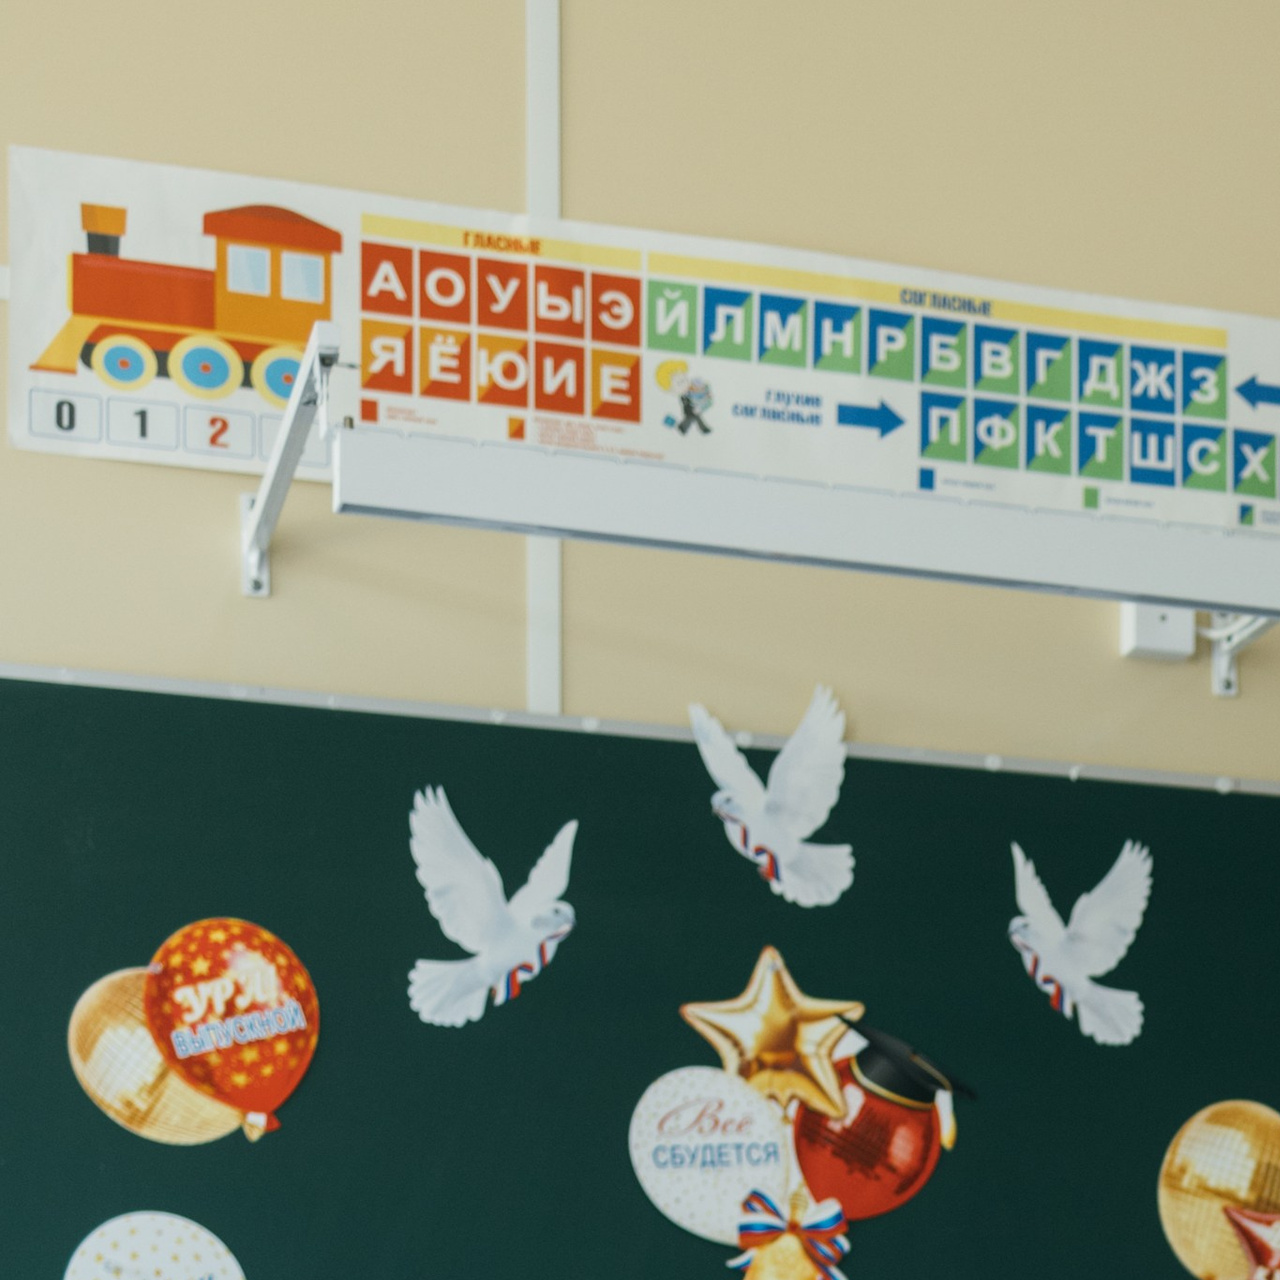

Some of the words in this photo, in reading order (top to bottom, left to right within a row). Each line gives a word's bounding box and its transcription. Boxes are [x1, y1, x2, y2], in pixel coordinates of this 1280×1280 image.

[462, 231, 541, 255] ГЛАСНЫЕ
[367, 261, 407, 301] А
[425, 268, 466, 307] О
[486, 274, 521, 313] У
[536, 280, 584, 324] Ы
[599, 290, 634, 330] Э
[900, 287, 993, 317] СОГЛАСНЫЕ
[654, 288, 690, 338] Й
[709, 304, 747, 347] Л
[763, 310, 805, 353] М
[821, 318, 856, 360] Н
[876, 325, 908, 364] Р
[928, 333, 963, 373] Б
[980, 340, 1015, 381] В
[1034, 348, 1063, 386] Г
[1082, 354, 1120, 400] Д
[1131, 360, 1175, 401] Ж
[1190, 366, 1221, 406] З
[369, 335, 406, 377] Я
[428, 334, 462, 384] Ё
[478, 348, 530, 391] Ю
[542, 356, 577, 398] И
[600, 364, 632, 405] Е
[54, 400, 76, 431] 0
[133, 409, 148, 439] 1
[208, 416, 229, 448] 2
[928, 406, 962, 447] П
[976, 413, 1018, 450] Ф
[1034, 420, 1065, 460] К
[1085, 425, 1117, 465] Т
[1131, 431, 1175, 472] Ш
[1187, 438, 1221, 477] С
[1240, 444, 1272, 484] Х
[170, 997, 307, 1060] ВЫПУСКНОЙ
[652, 1140, 781, 1170] СБУДЕТСЯ
